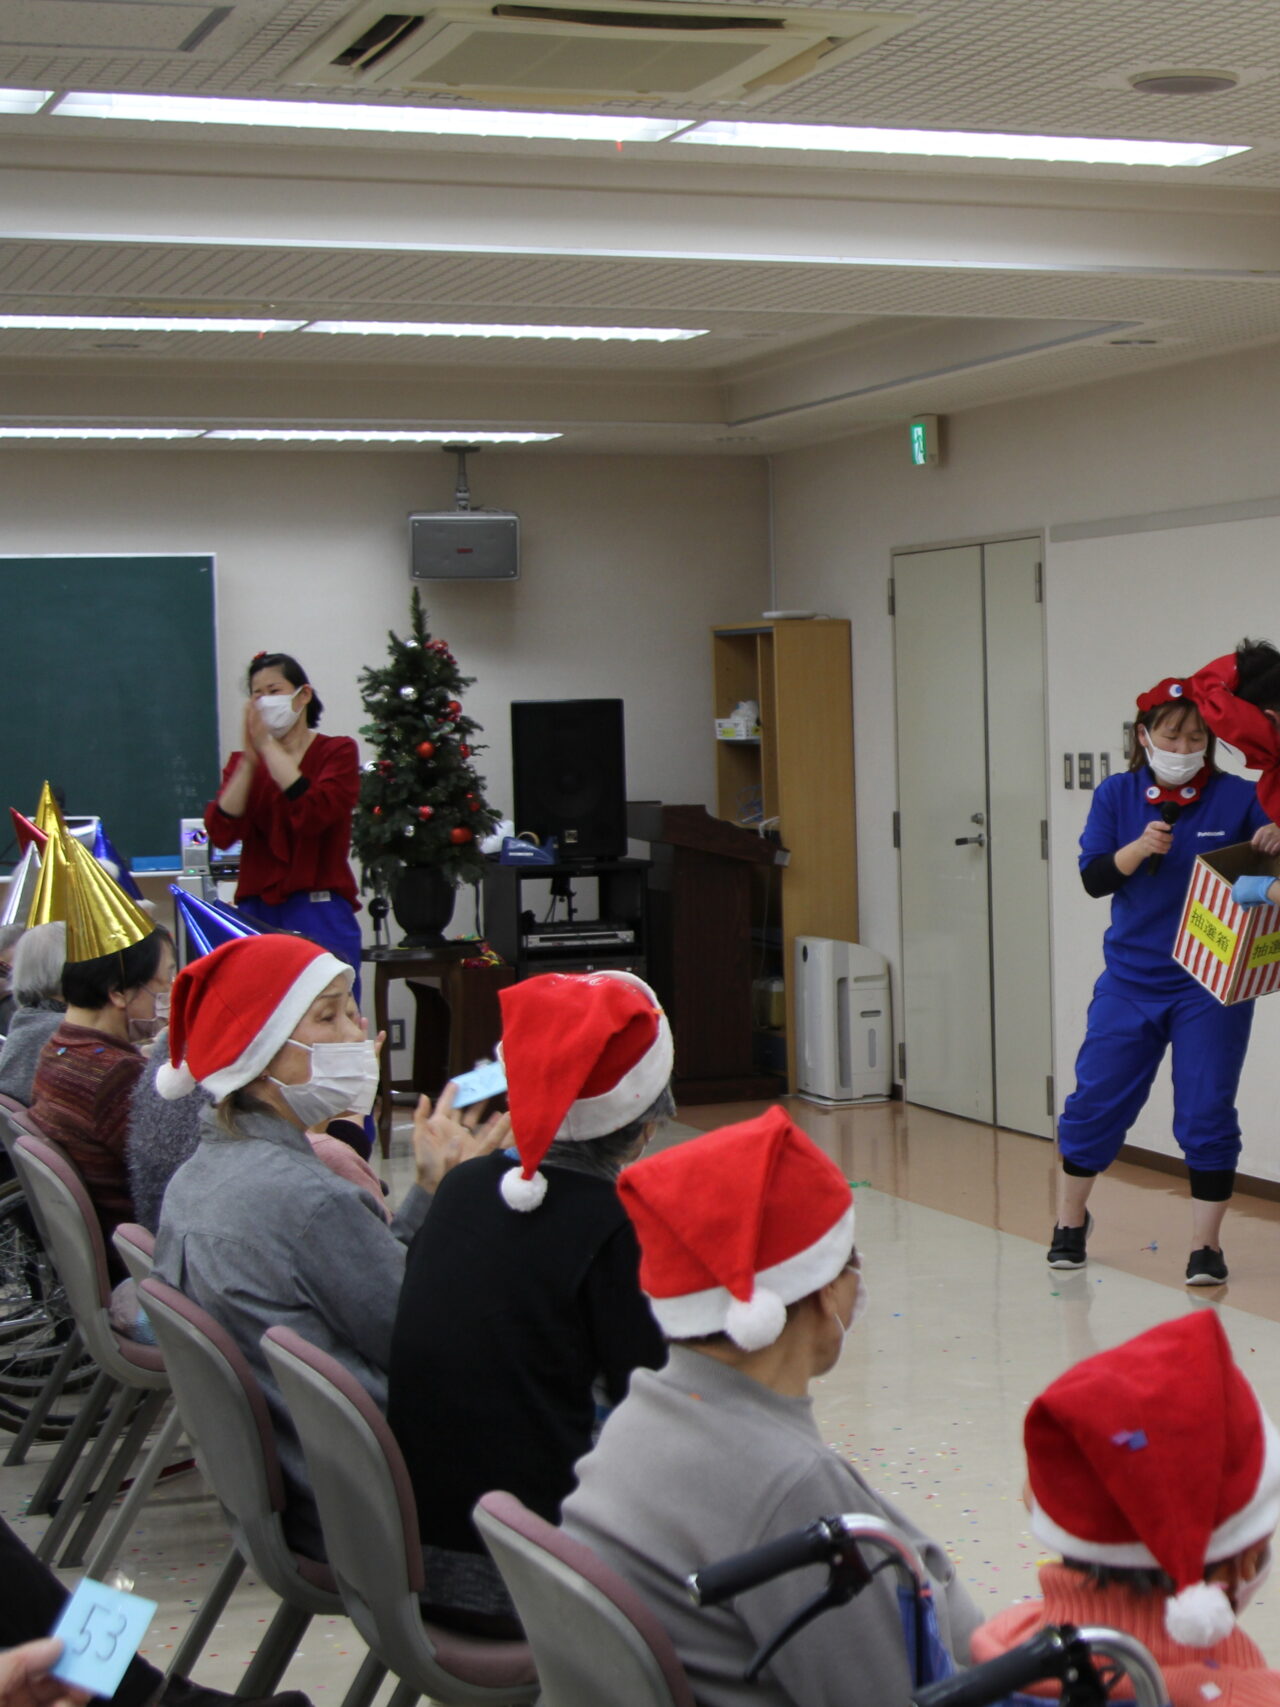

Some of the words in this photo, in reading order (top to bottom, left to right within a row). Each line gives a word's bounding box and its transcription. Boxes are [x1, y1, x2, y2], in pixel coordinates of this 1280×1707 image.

[1190, 909, 1231, 954] 抽選箱
[71, 1602, 128, 1663] 53
